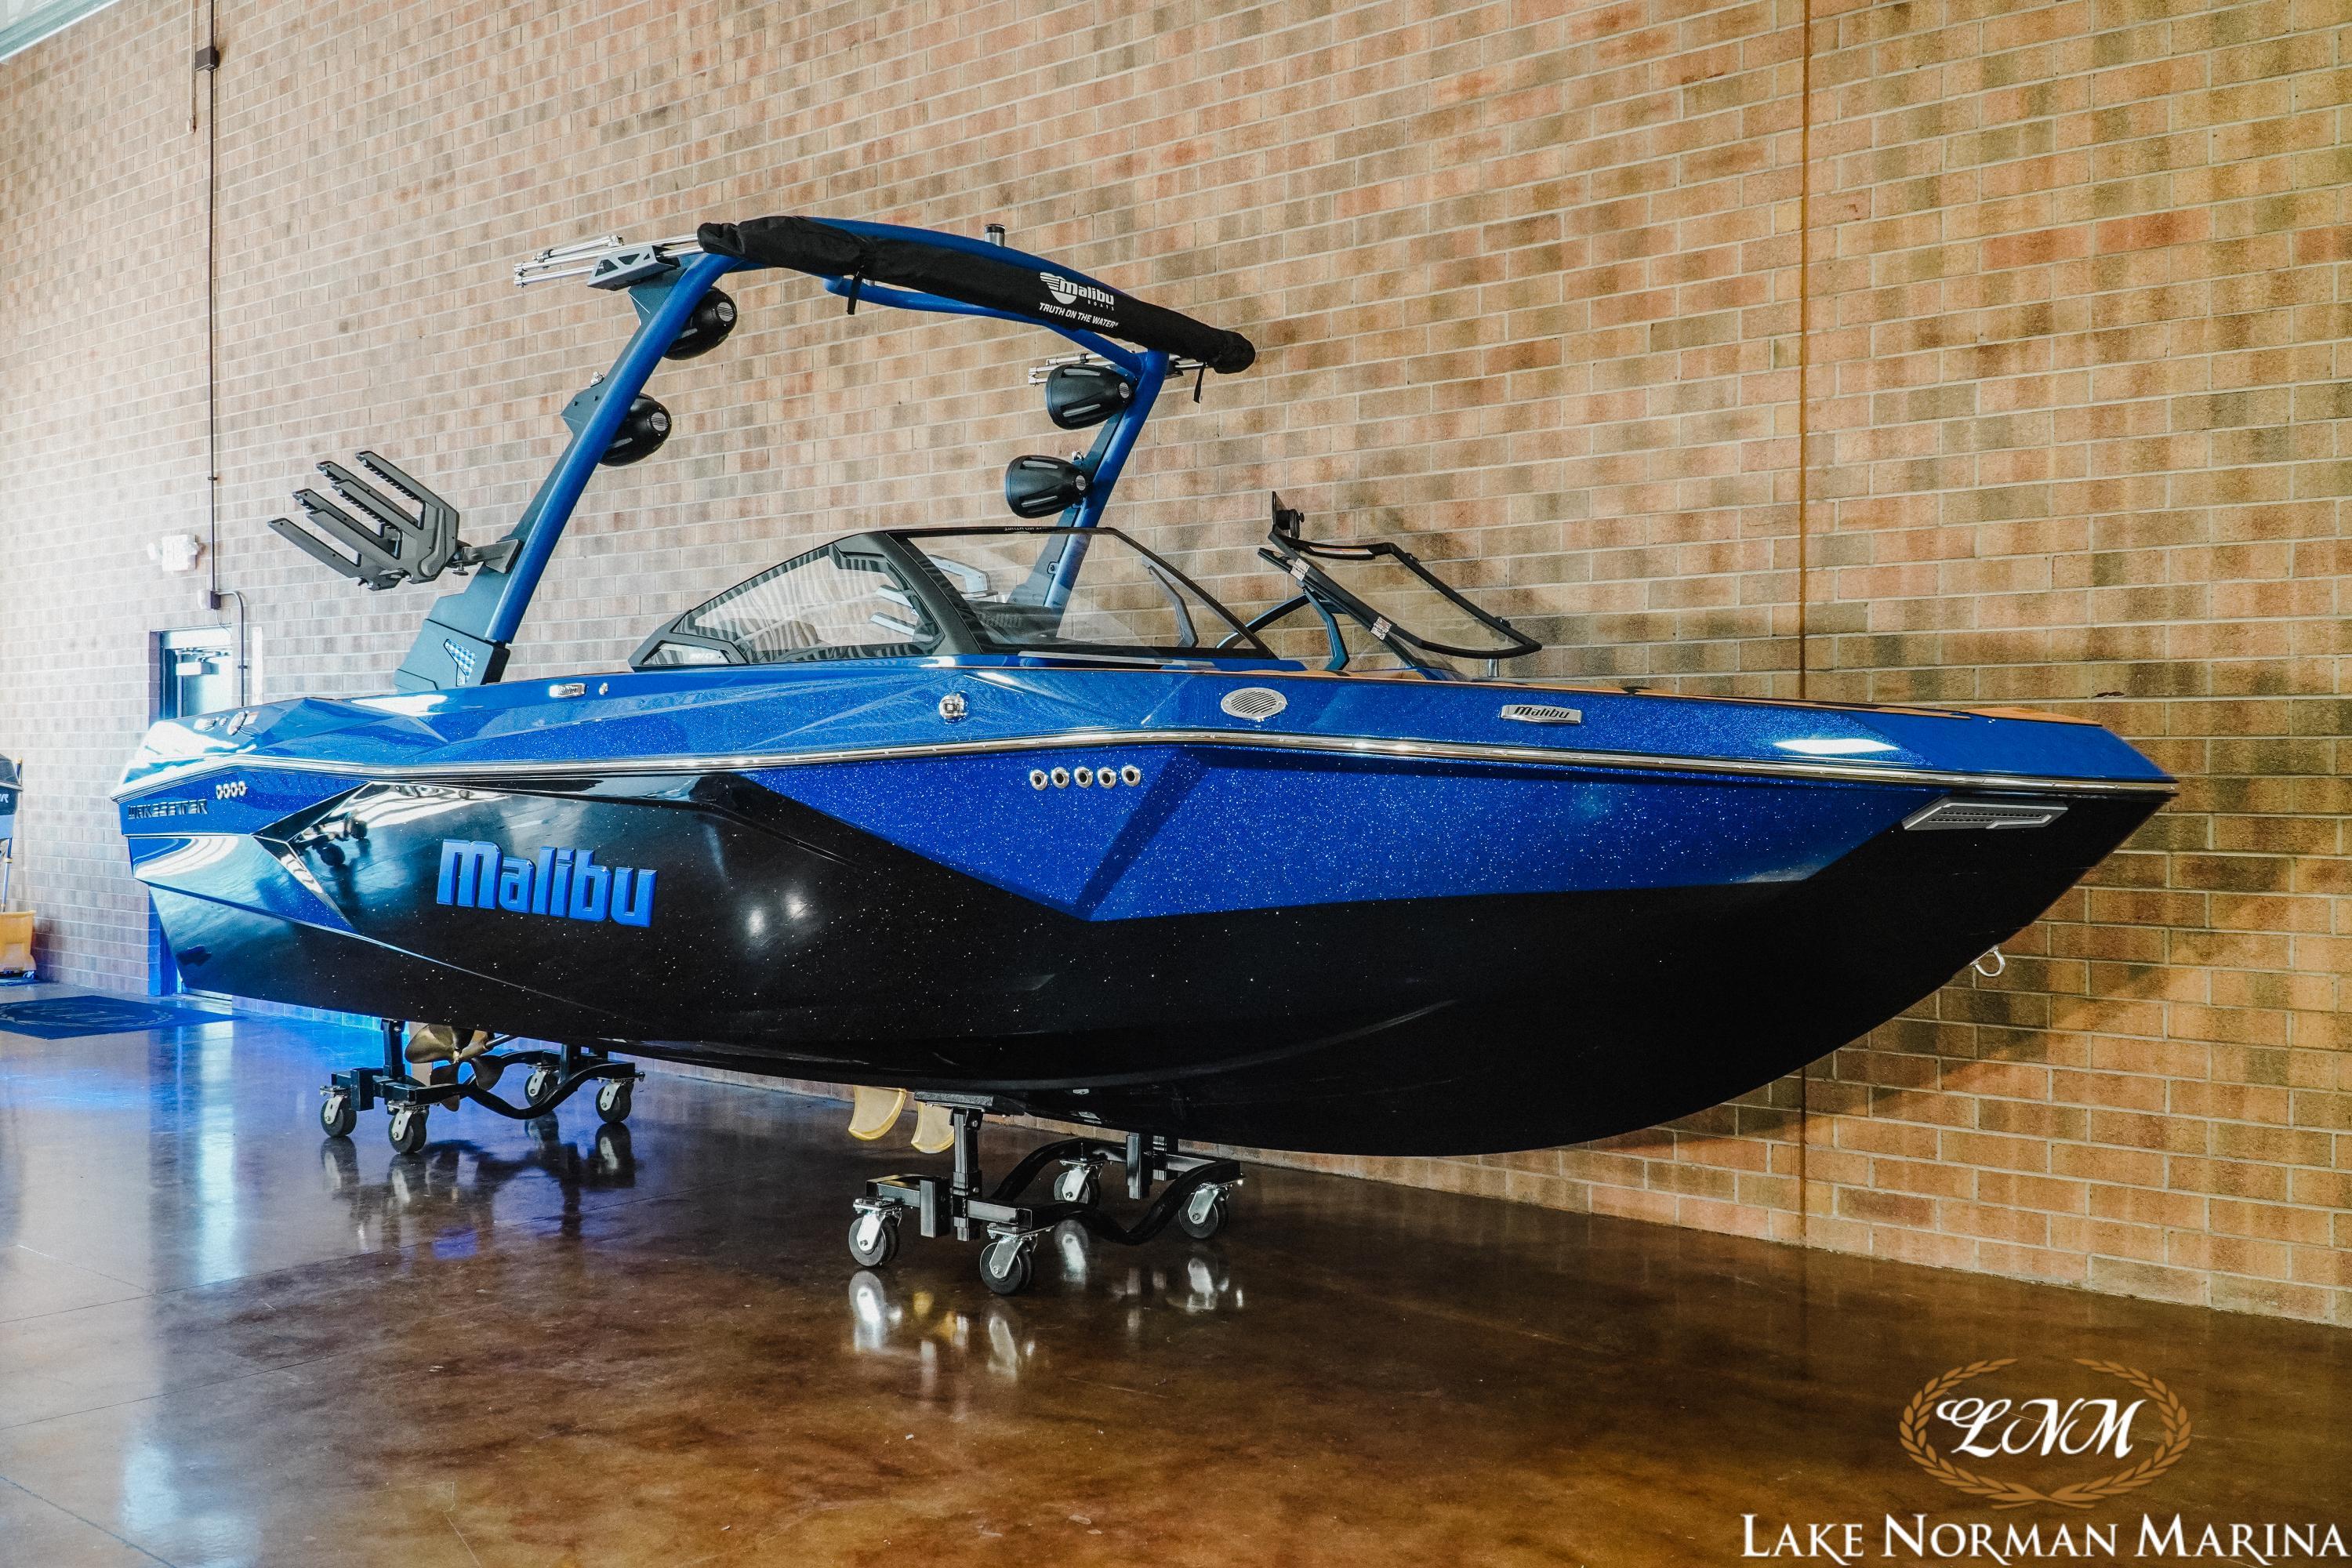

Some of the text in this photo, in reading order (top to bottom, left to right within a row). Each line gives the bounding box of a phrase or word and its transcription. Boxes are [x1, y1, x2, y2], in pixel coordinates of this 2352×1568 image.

[1087, 300, 1114, 310] BOATS
[1039, 303, 1065, 316] TRUTH
[1065, 310, 1076, 319] ON
[1077, 312, 1092, 322] THE
